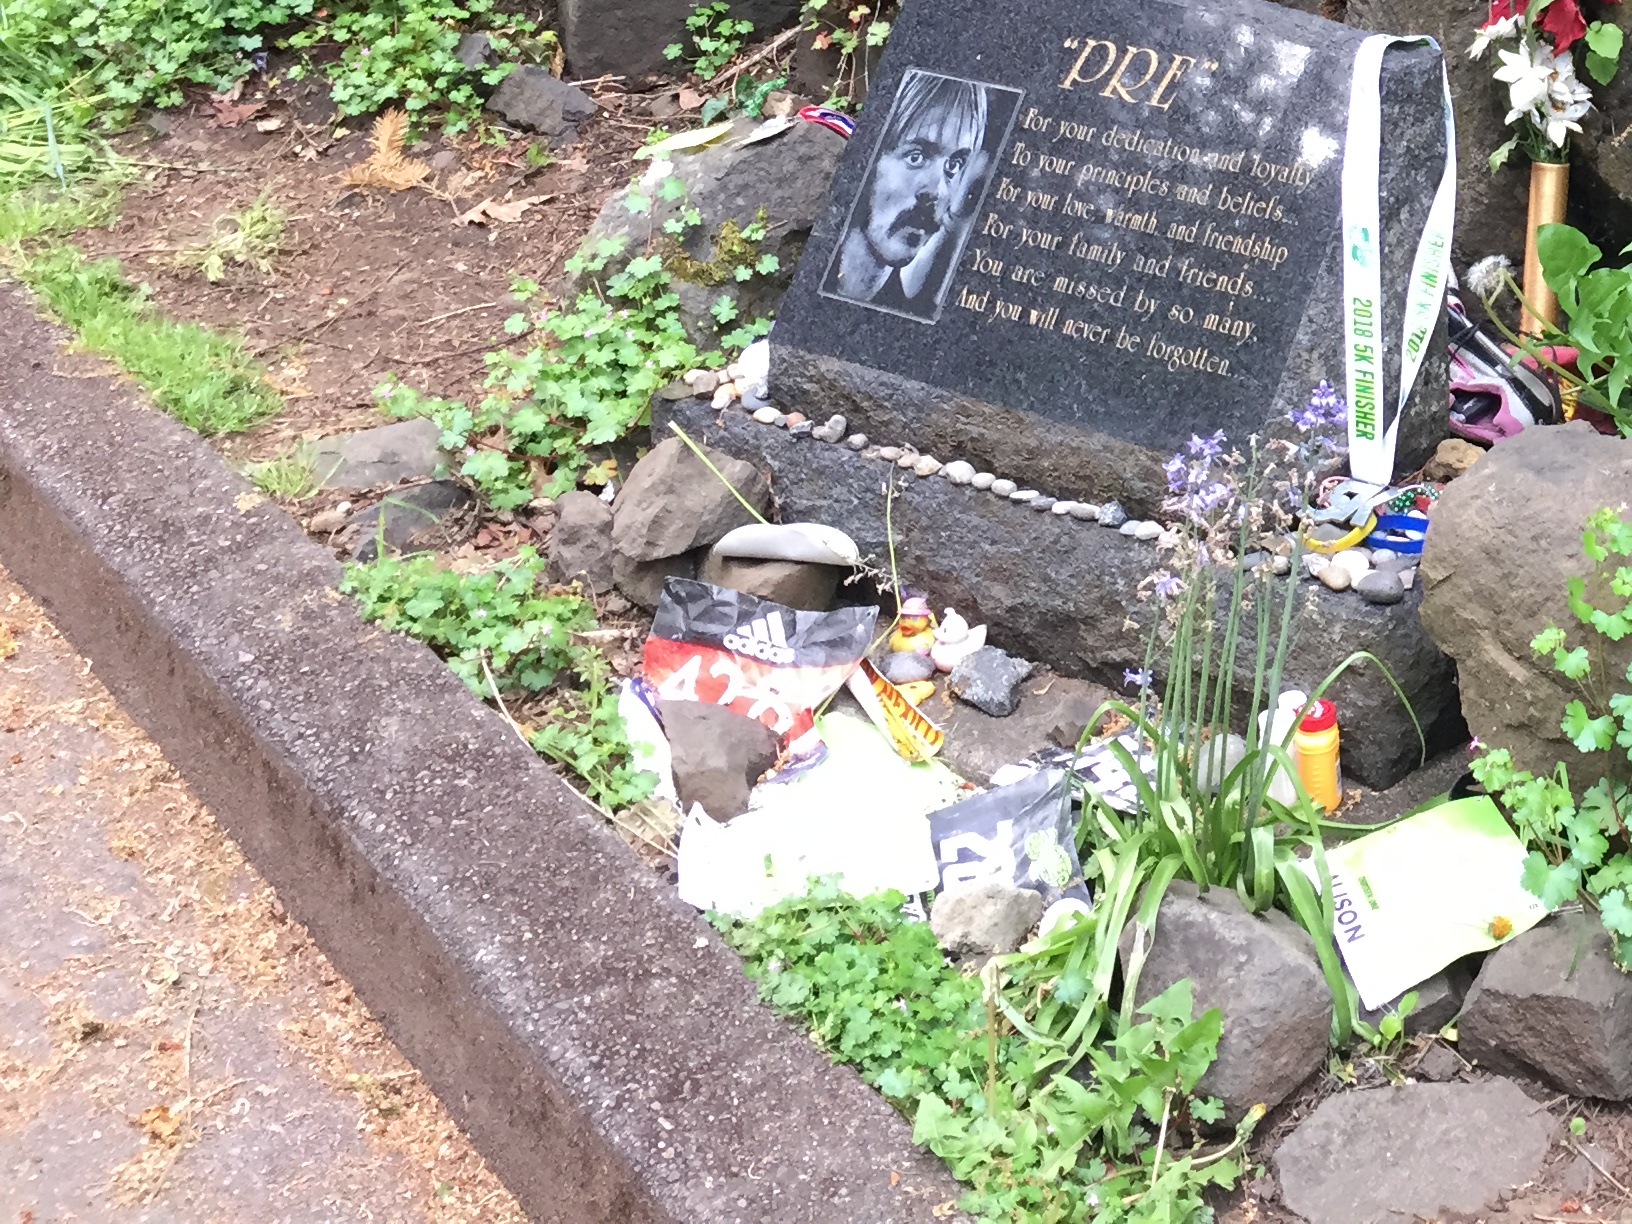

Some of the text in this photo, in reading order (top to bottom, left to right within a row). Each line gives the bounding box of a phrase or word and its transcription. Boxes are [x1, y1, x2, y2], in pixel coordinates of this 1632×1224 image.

[1011, 141, 1032, 167] To
[1034, 150, 1074, 177] your
[1080, 163, 1169, 198] principles
[1176, 182, 1213, 206] and
[1021, 107, 1315, 194] For your dedication and loyalty
[981, 212, 1010, 239] For
[1014, 226, 1062, 251] your
[1068, 231, 1127, 273] family
[1133, 254, 1174, 278] and
[996, 177, 1021, 202] For
[1018, 190, 1059, 213] your
[1167, 219, 1200, 243] and
[1202, 222, 1289, 271] friendship
[955, 286, 990, 312] And
[988, 299, 1023, 323] you
[1028, 307, 1059, 331] will
[1062, 319, 1111, 344] never
[1115, 326, 1142, 353] be
[970, 248, 1003, 276] You
[1011, 264, 1046, 287] are
[1052, 275, 1128, 308] missed
[1134, 289, 1161, 322] by
[1167, 304, 1195, 324] so
[1353, 297, 1376, 441] 2018 5K FINISHER
[723, 633, 795, 664] adidas
